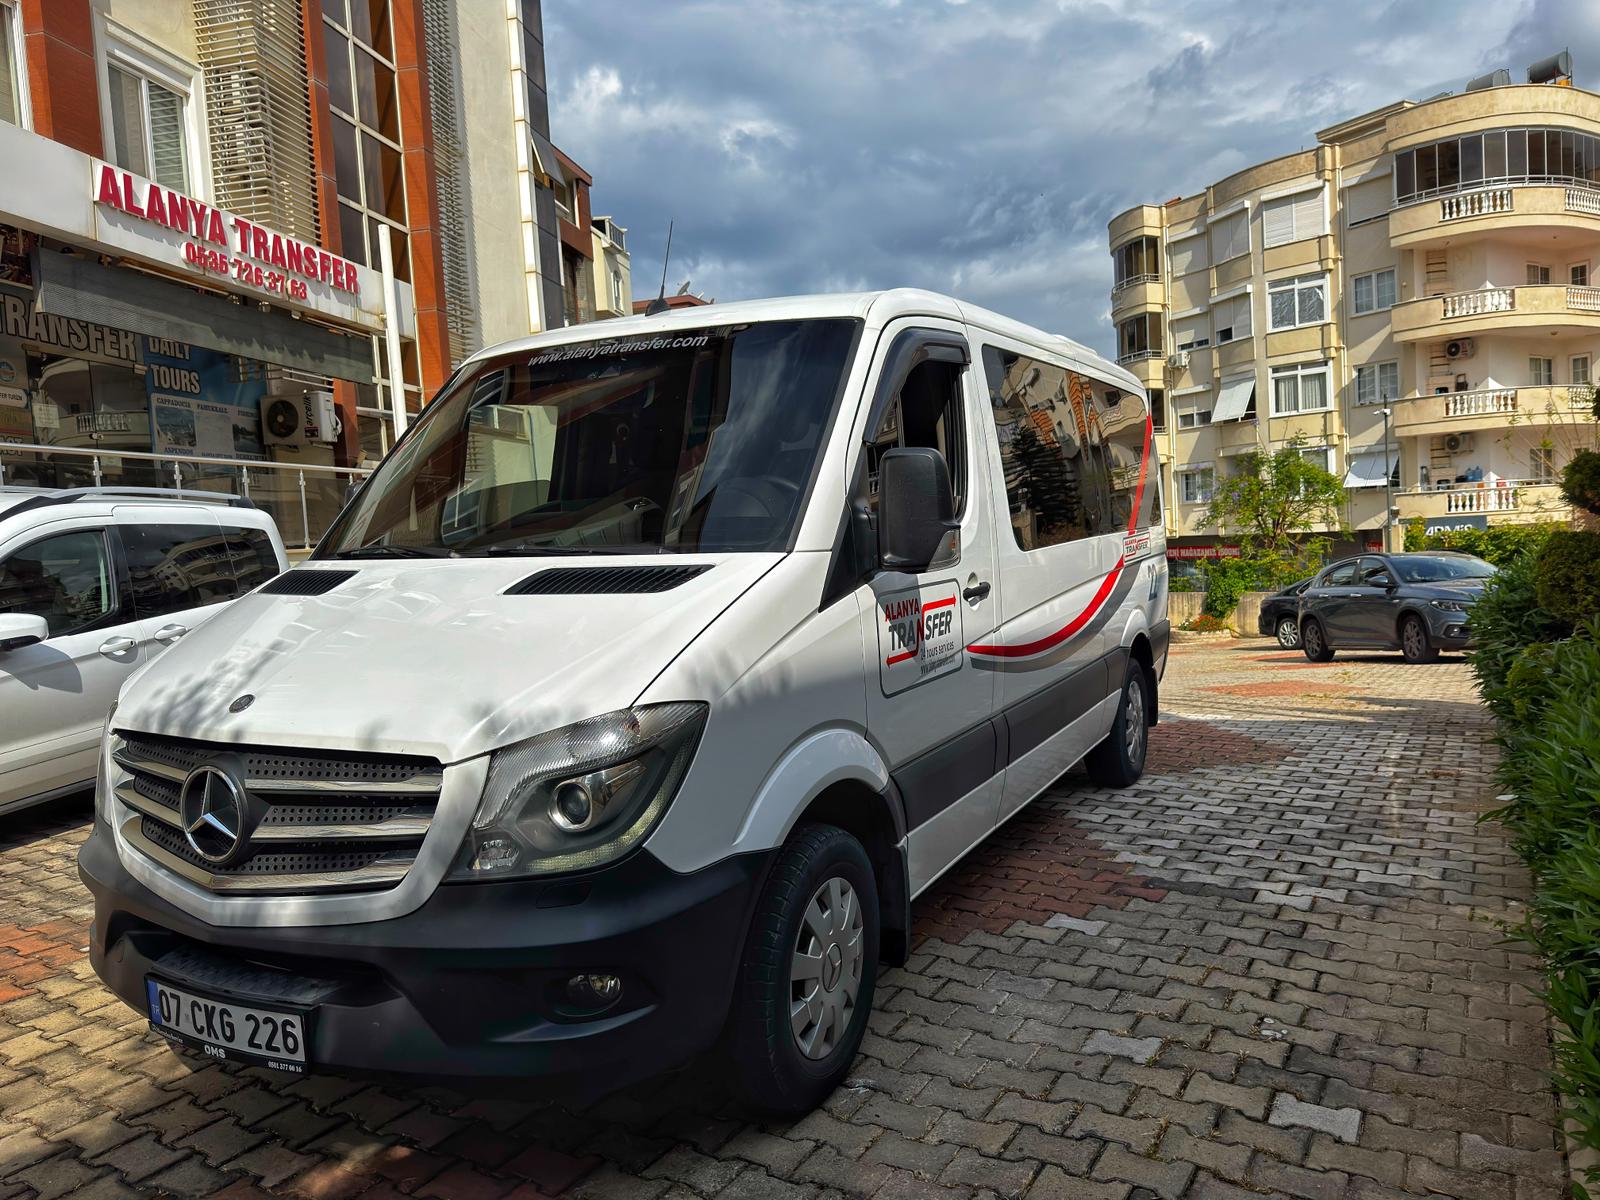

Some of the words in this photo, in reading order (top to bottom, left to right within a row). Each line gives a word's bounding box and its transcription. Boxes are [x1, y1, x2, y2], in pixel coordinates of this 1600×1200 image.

[98, 165, 228, 247] ALANYA
[233, 217, 360, 295] TRANSFER
[185, 242, 229, 275] 0535
[234, 258, 264, 287] 726
[267, 271, 285, 293] 37
[290, 280, 307, 300] 63
[149, 337, 191, 360] DAILY
[527, 335, 709, 367] www.alanyatransfer.com
[151, 364, 200, 394] TOURS
[885, 598, 921, 622] ALANYA
[889, 610, 953, 651] TRANSFER
[158, 989, 181, 1027] 07
[190, 1000, 235, 1043] CKG
[245, 1014, 299, 1055] 226
[204, 1044, 226, 1059] OMS
